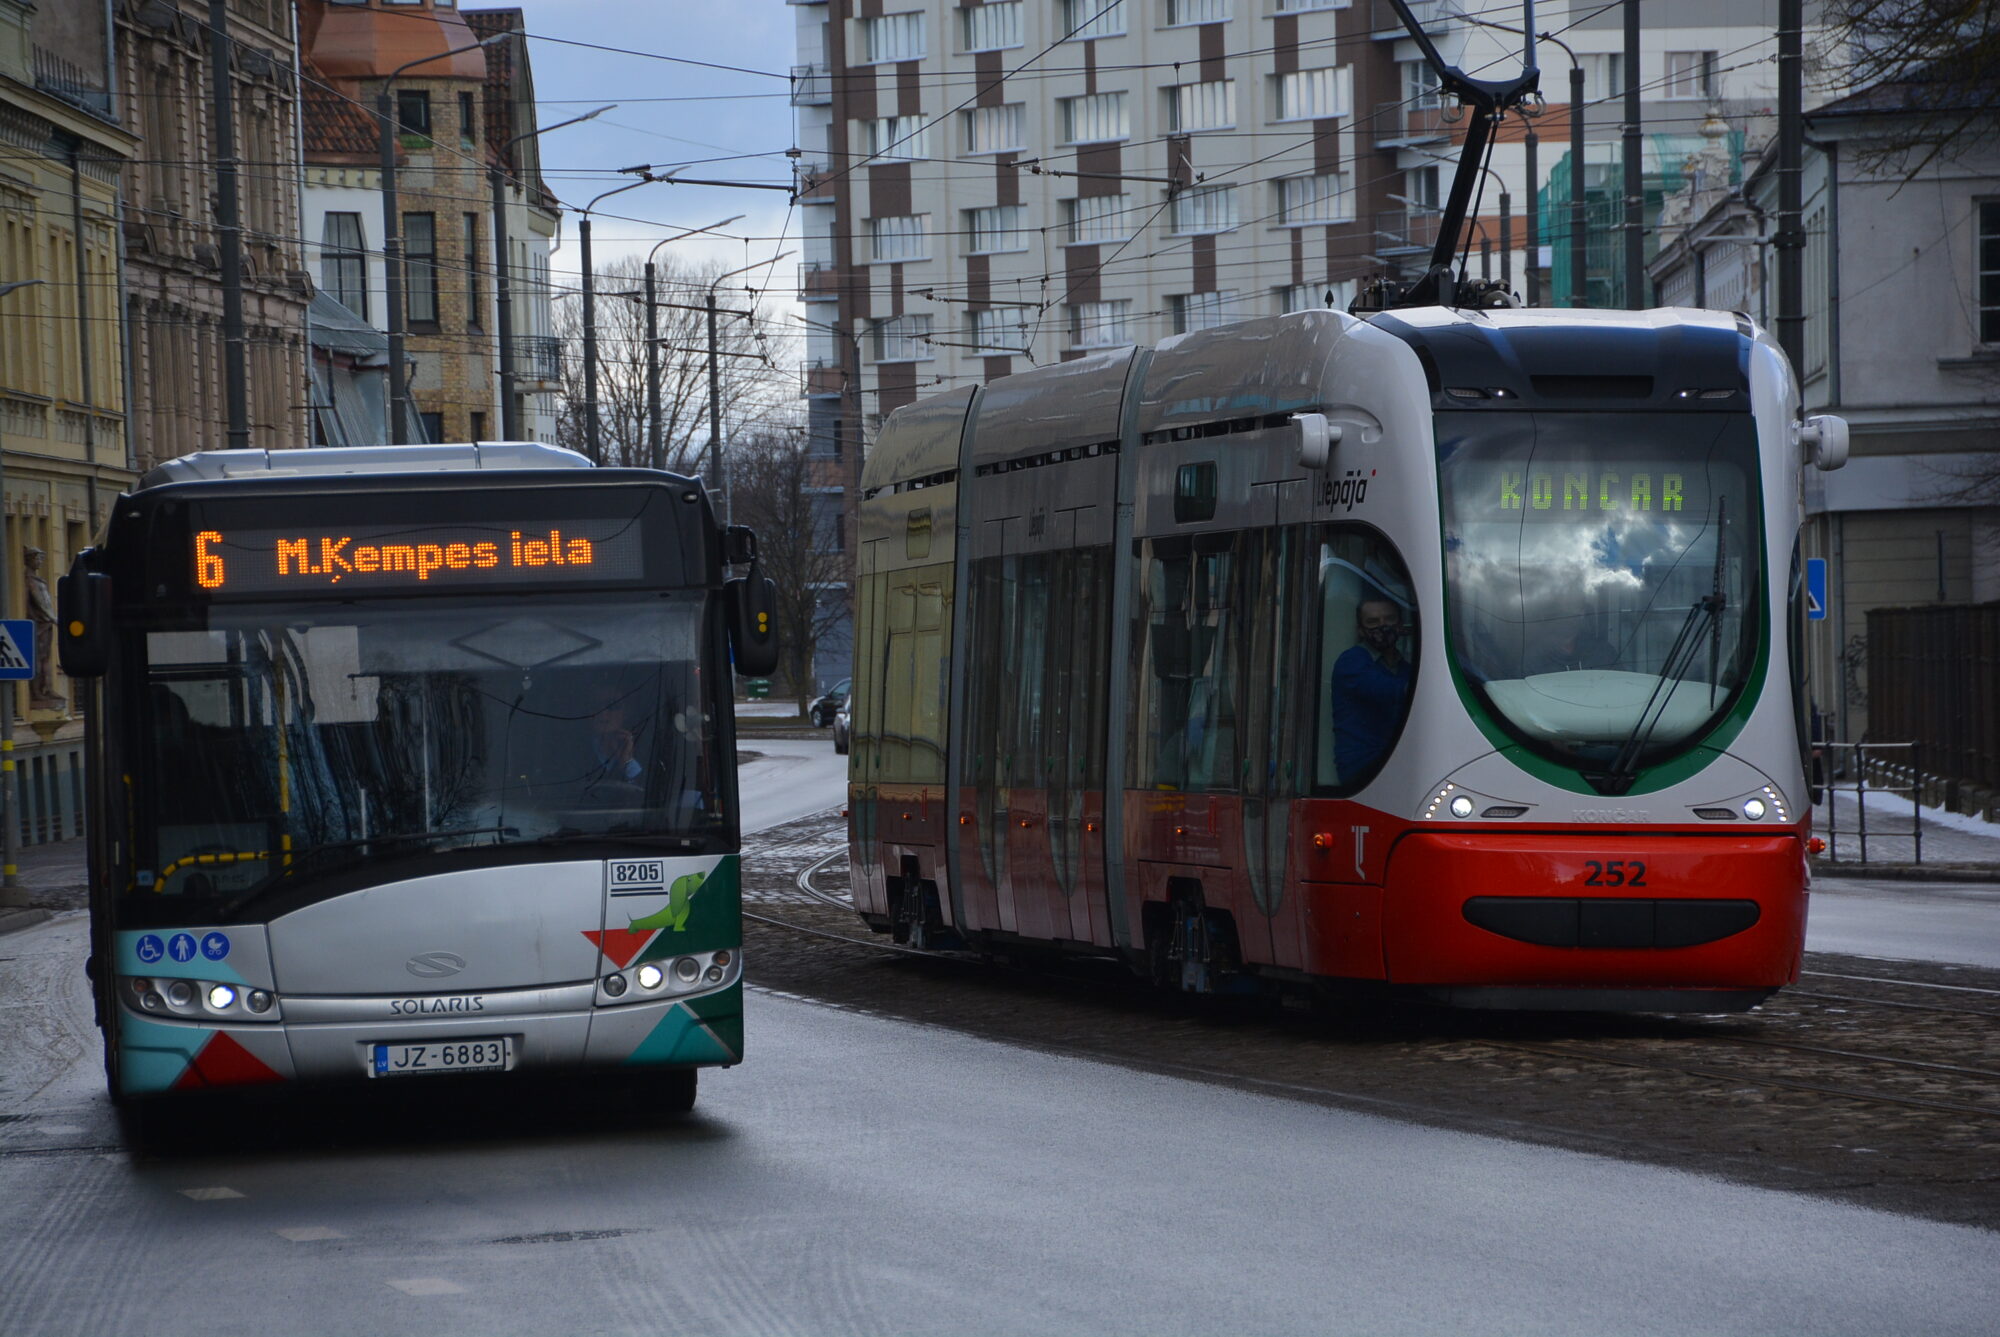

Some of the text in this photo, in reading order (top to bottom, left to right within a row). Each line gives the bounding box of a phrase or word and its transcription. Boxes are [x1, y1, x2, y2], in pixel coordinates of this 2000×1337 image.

[196, 529, 593, 588] 6 M.Ķempes iela
[616, 863, 659, 881] 8205
[1583, 860, 1647, 887] 252
[390, 996, 483, 1015] SOLARIS
[394, 1043, 500, 1068] JZ-6883
